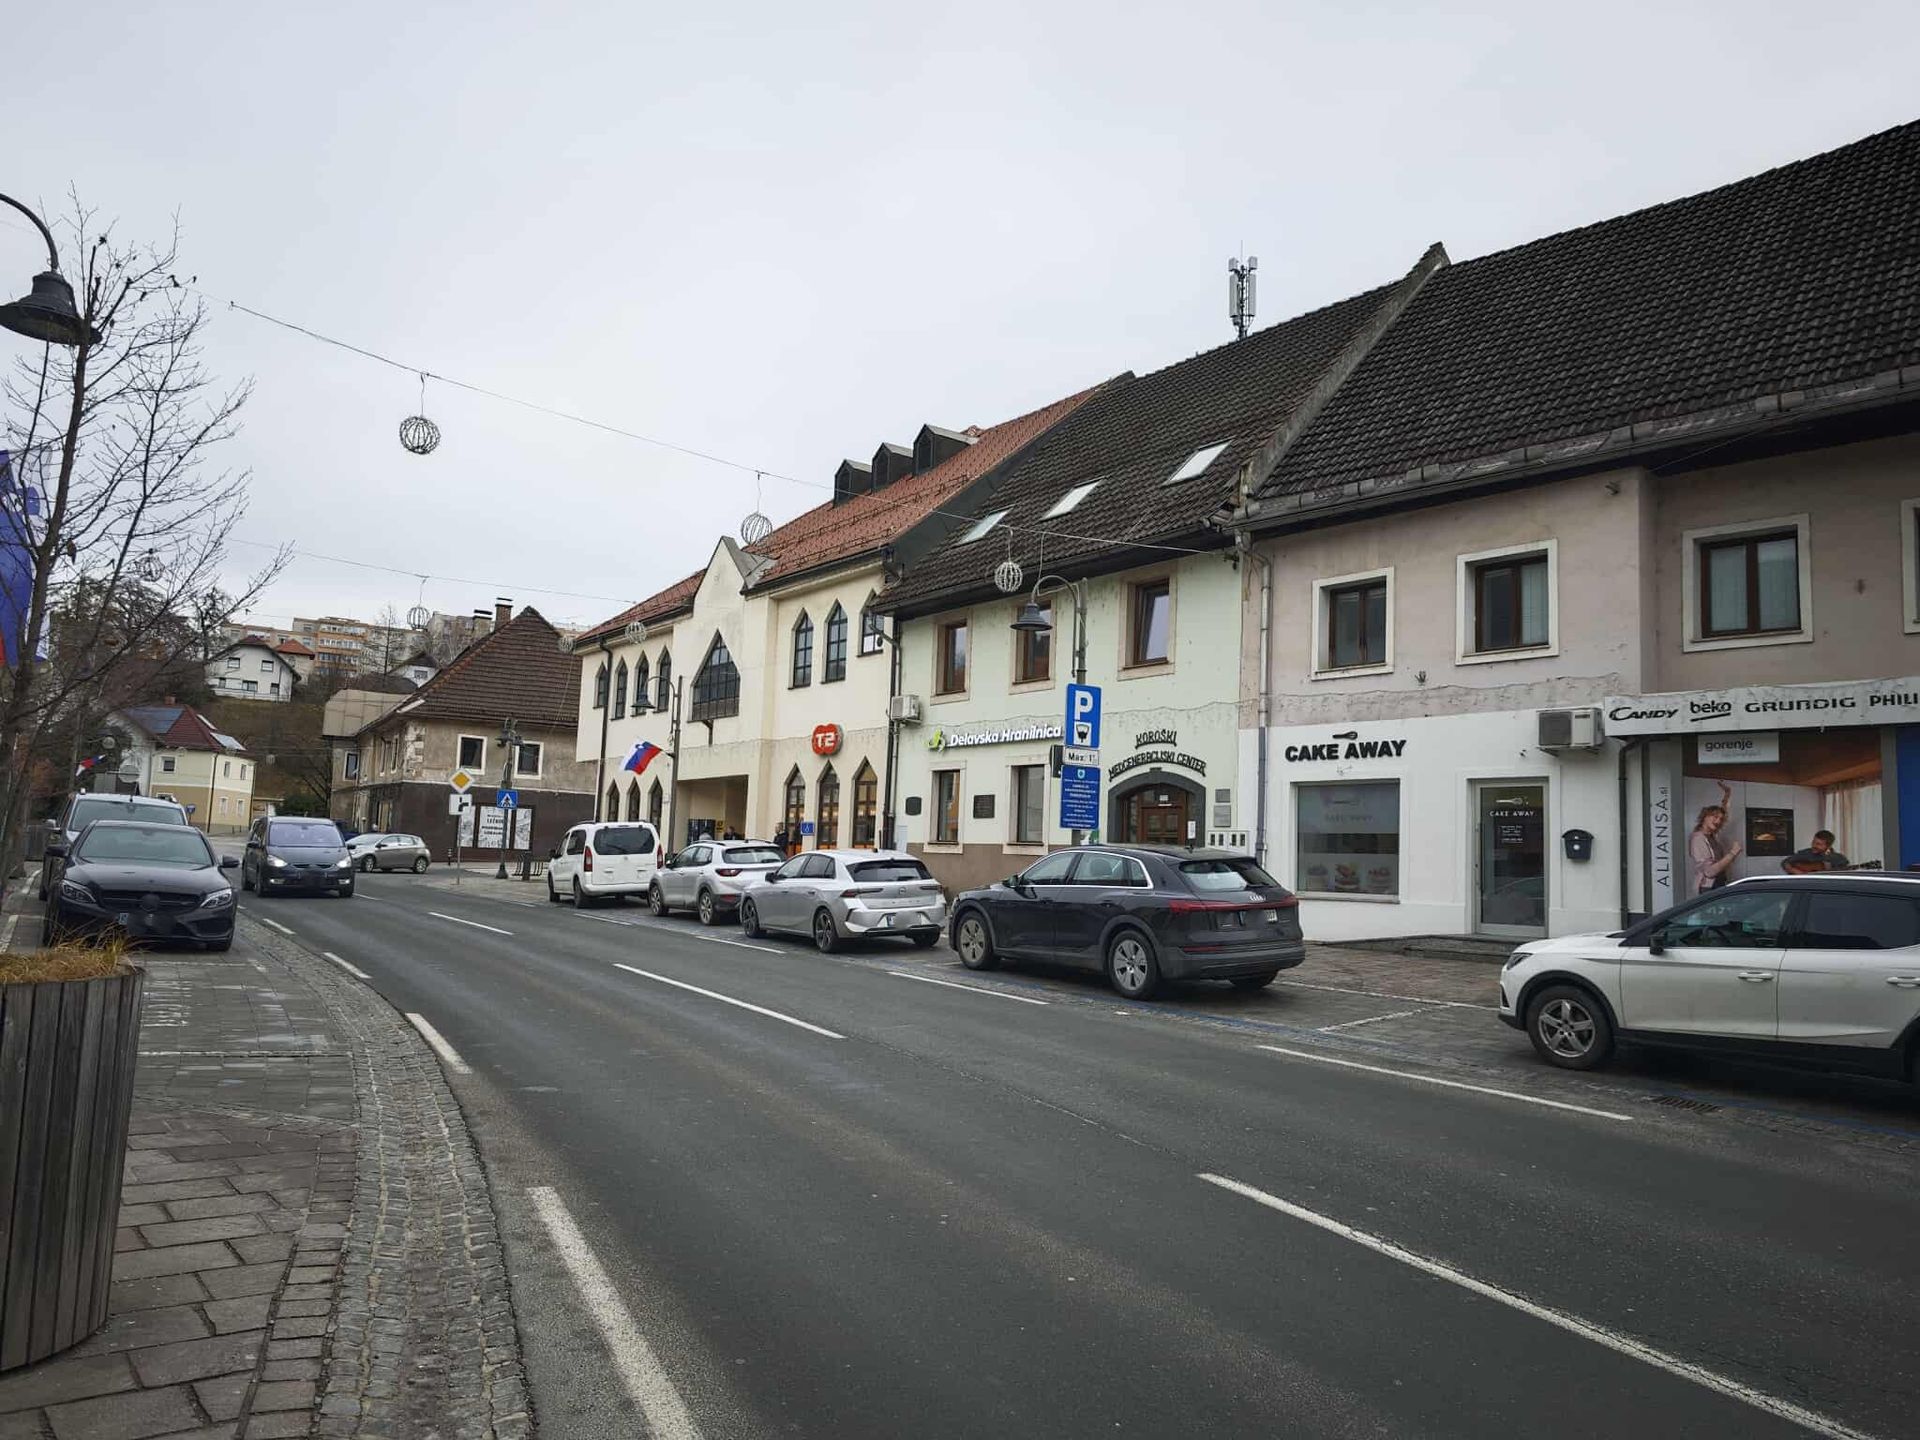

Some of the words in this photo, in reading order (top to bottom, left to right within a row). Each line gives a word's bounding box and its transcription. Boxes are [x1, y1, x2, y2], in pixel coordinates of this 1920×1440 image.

[1074, 690, 1093, 720] P
[1609, 706, 1679, 721] CANDY
[1690, 700, 1732, 714] beko
[1745, 697, 1856, 713] GRUNDIG
[815, 731, 836, 748] T2
[950, 730, 999, 747] Delavska
[1001, 723, 1062, 742] Hranilnica
[1135, 728, 1177, 748] KOROŠKI
[1285, 743, 1339, 762] CAKE
[1344, 739, 1406, 759] AWAY
[1705, 739, 1753, 752] gorenje
[1176, 753, 1207, 778] CENTER
